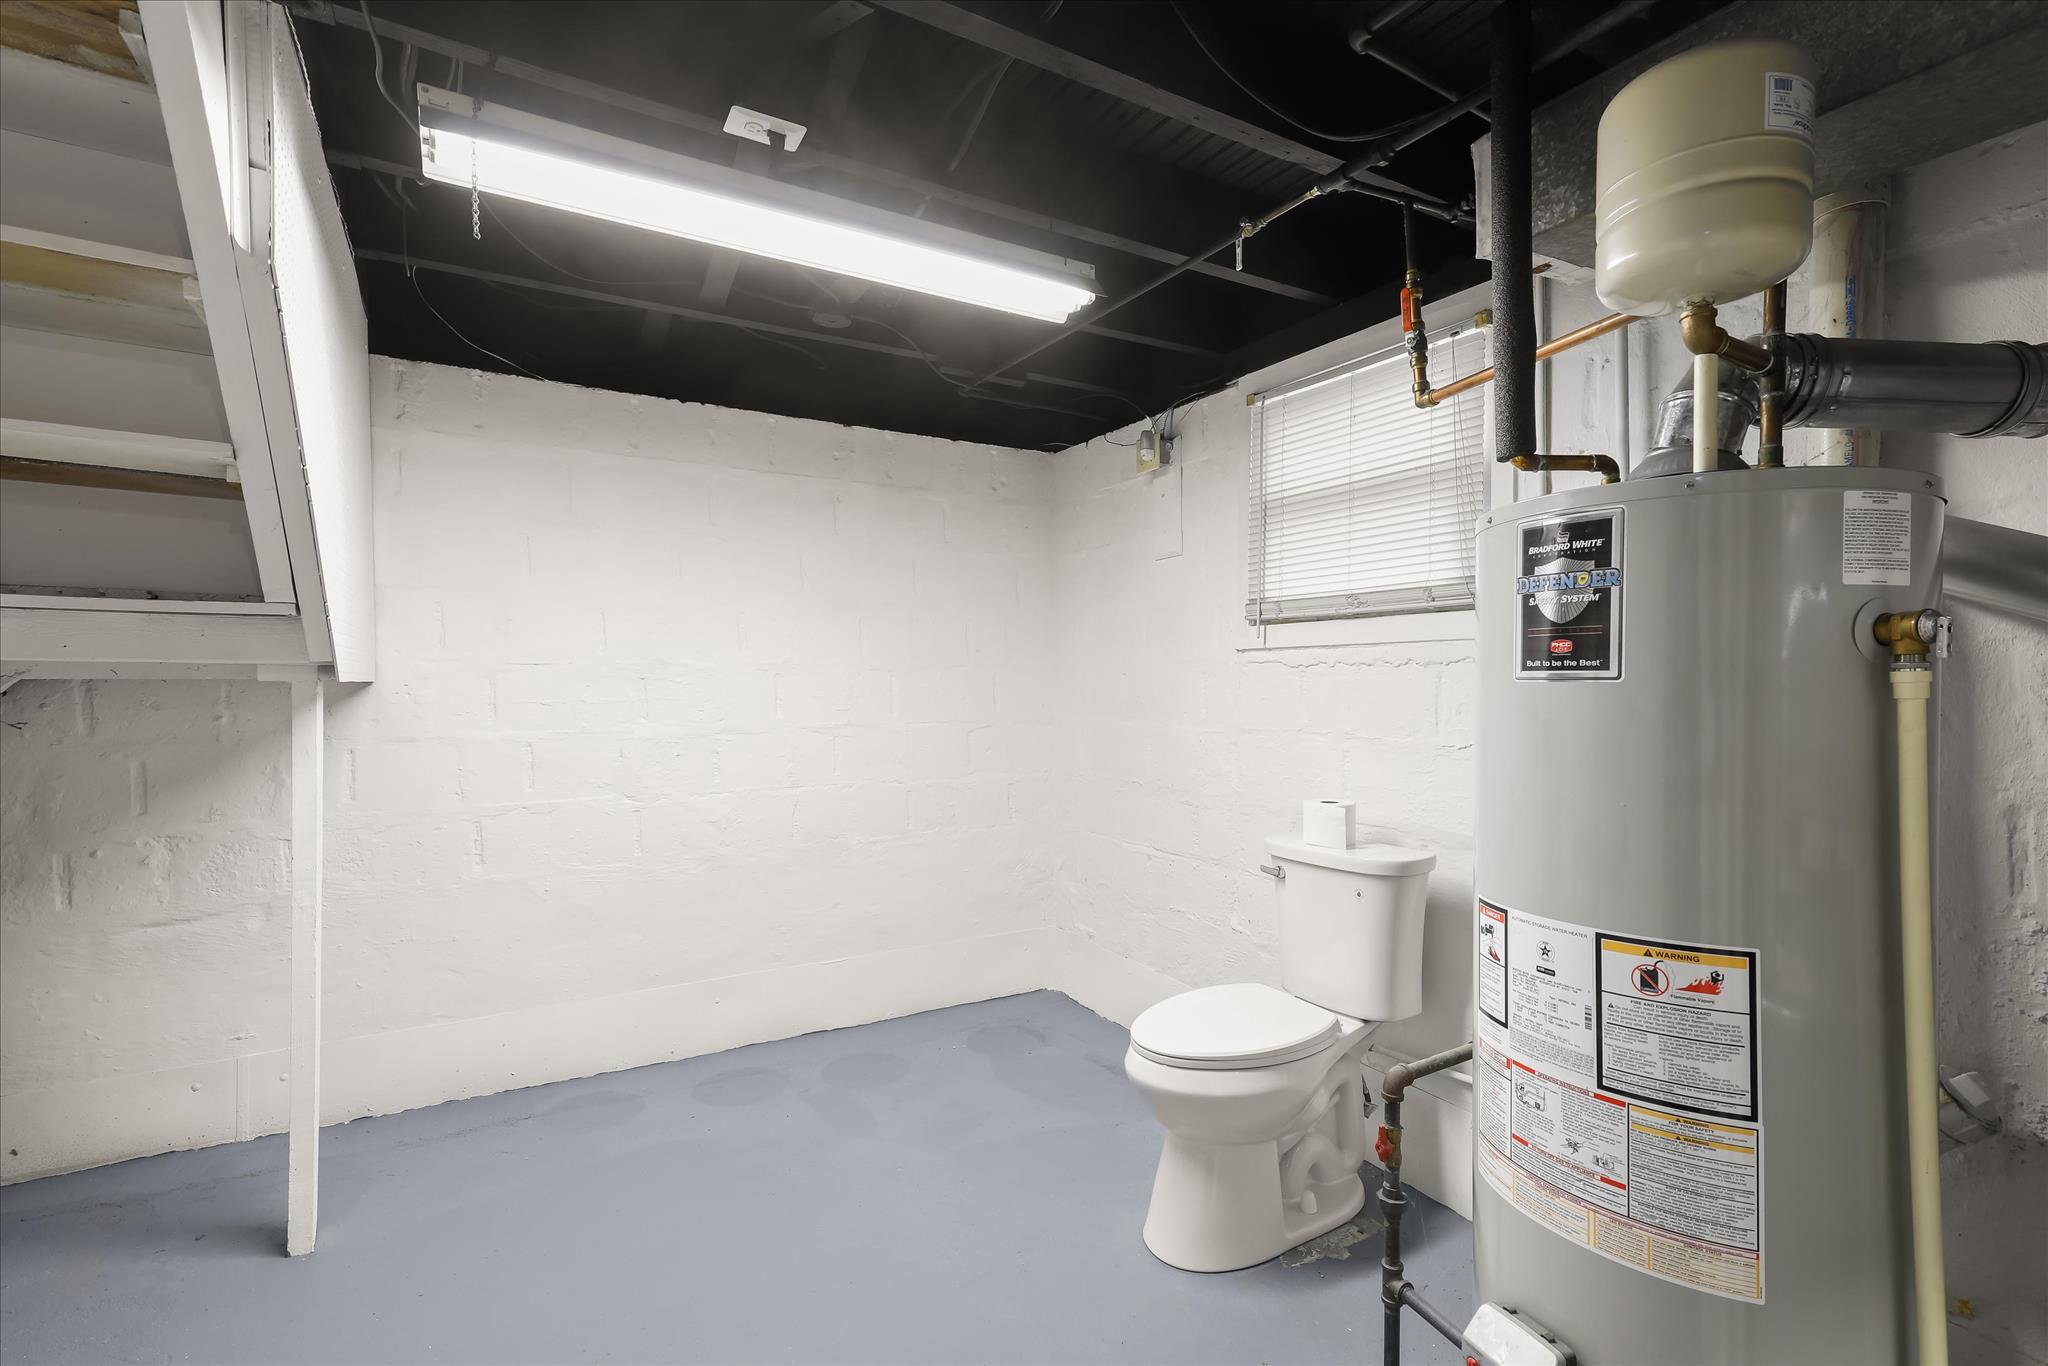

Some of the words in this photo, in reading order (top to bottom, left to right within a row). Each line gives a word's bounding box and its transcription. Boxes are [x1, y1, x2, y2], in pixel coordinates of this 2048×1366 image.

[1528, 543, 1570, 555] BRADFORD
[1572, 539, 1603, 549] WHITE
[1516, 568, 1622, 594] DEFENDER
[1560, 593, 1600, 604] SYSTEM
[1655, 951, 1700, 963] WARNING
[1683, 1119, 1710, 1128] WARNING
[1683, 1137, 1710, 1146] WARNING
